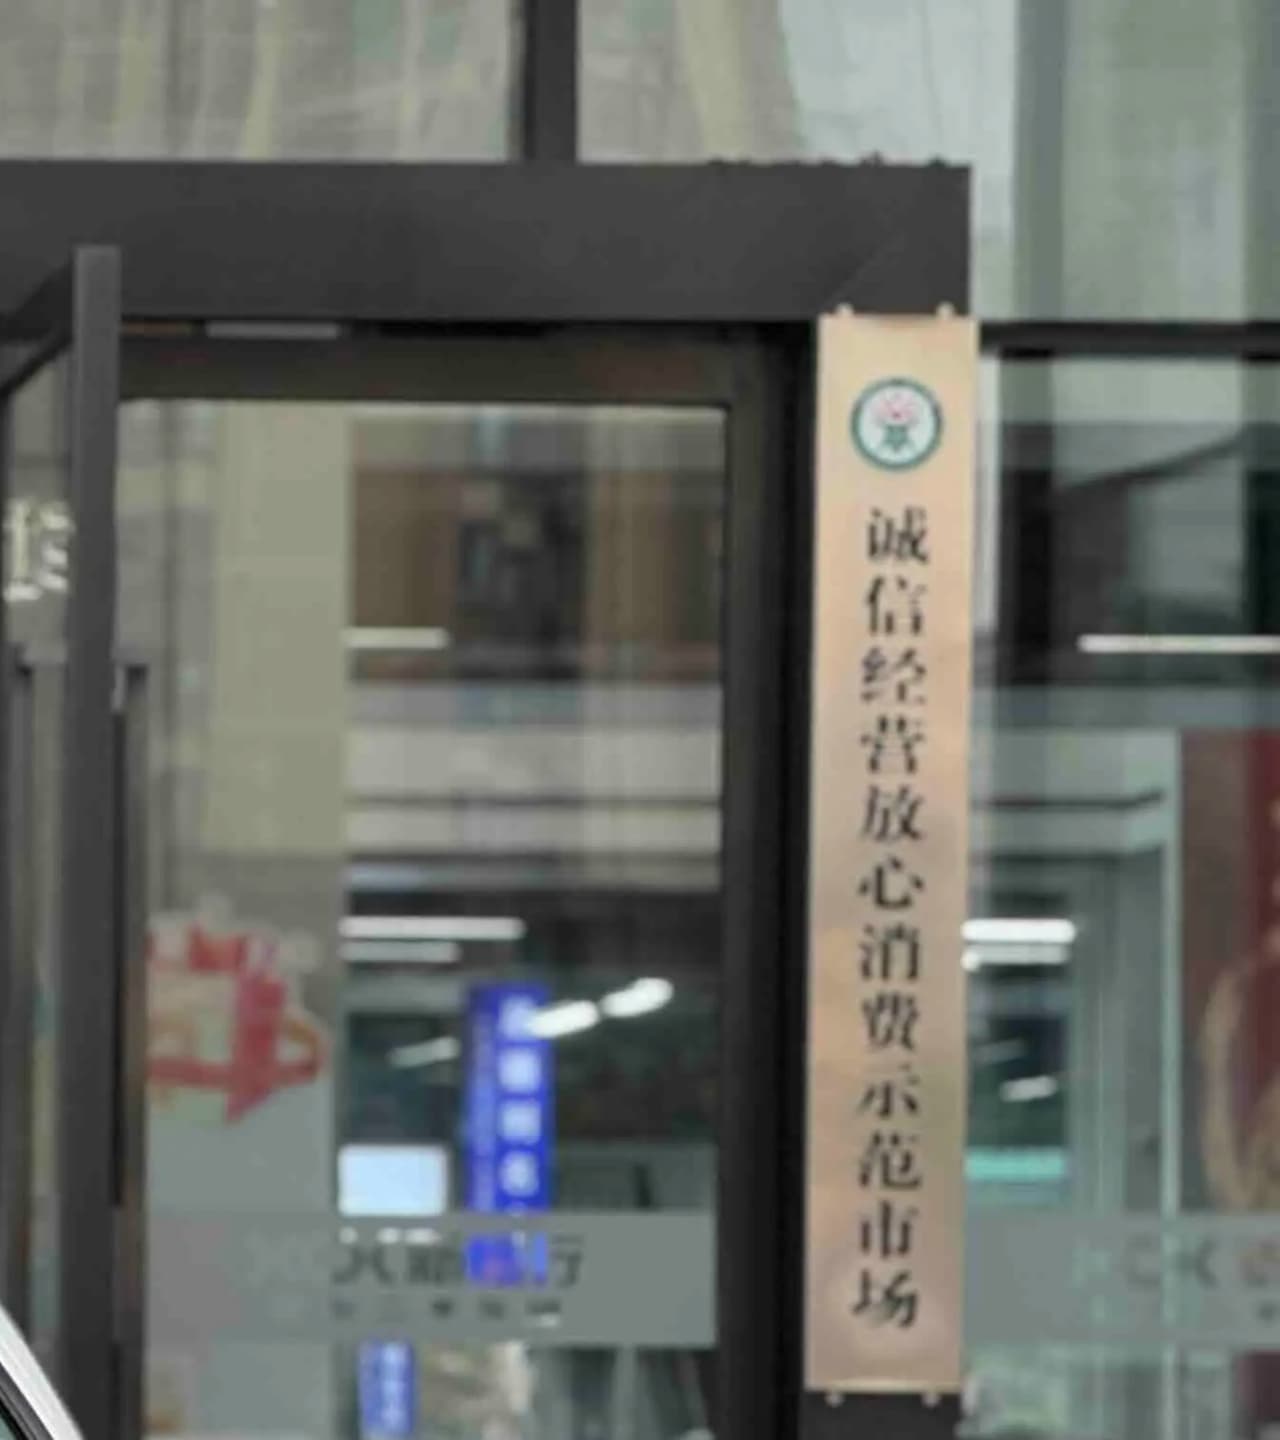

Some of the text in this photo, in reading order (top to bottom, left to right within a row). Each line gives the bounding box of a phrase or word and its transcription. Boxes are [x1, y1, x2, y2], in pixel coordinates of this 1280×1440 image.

[851, 508, 928, 1329] 诚信经营放心消费示范市场
